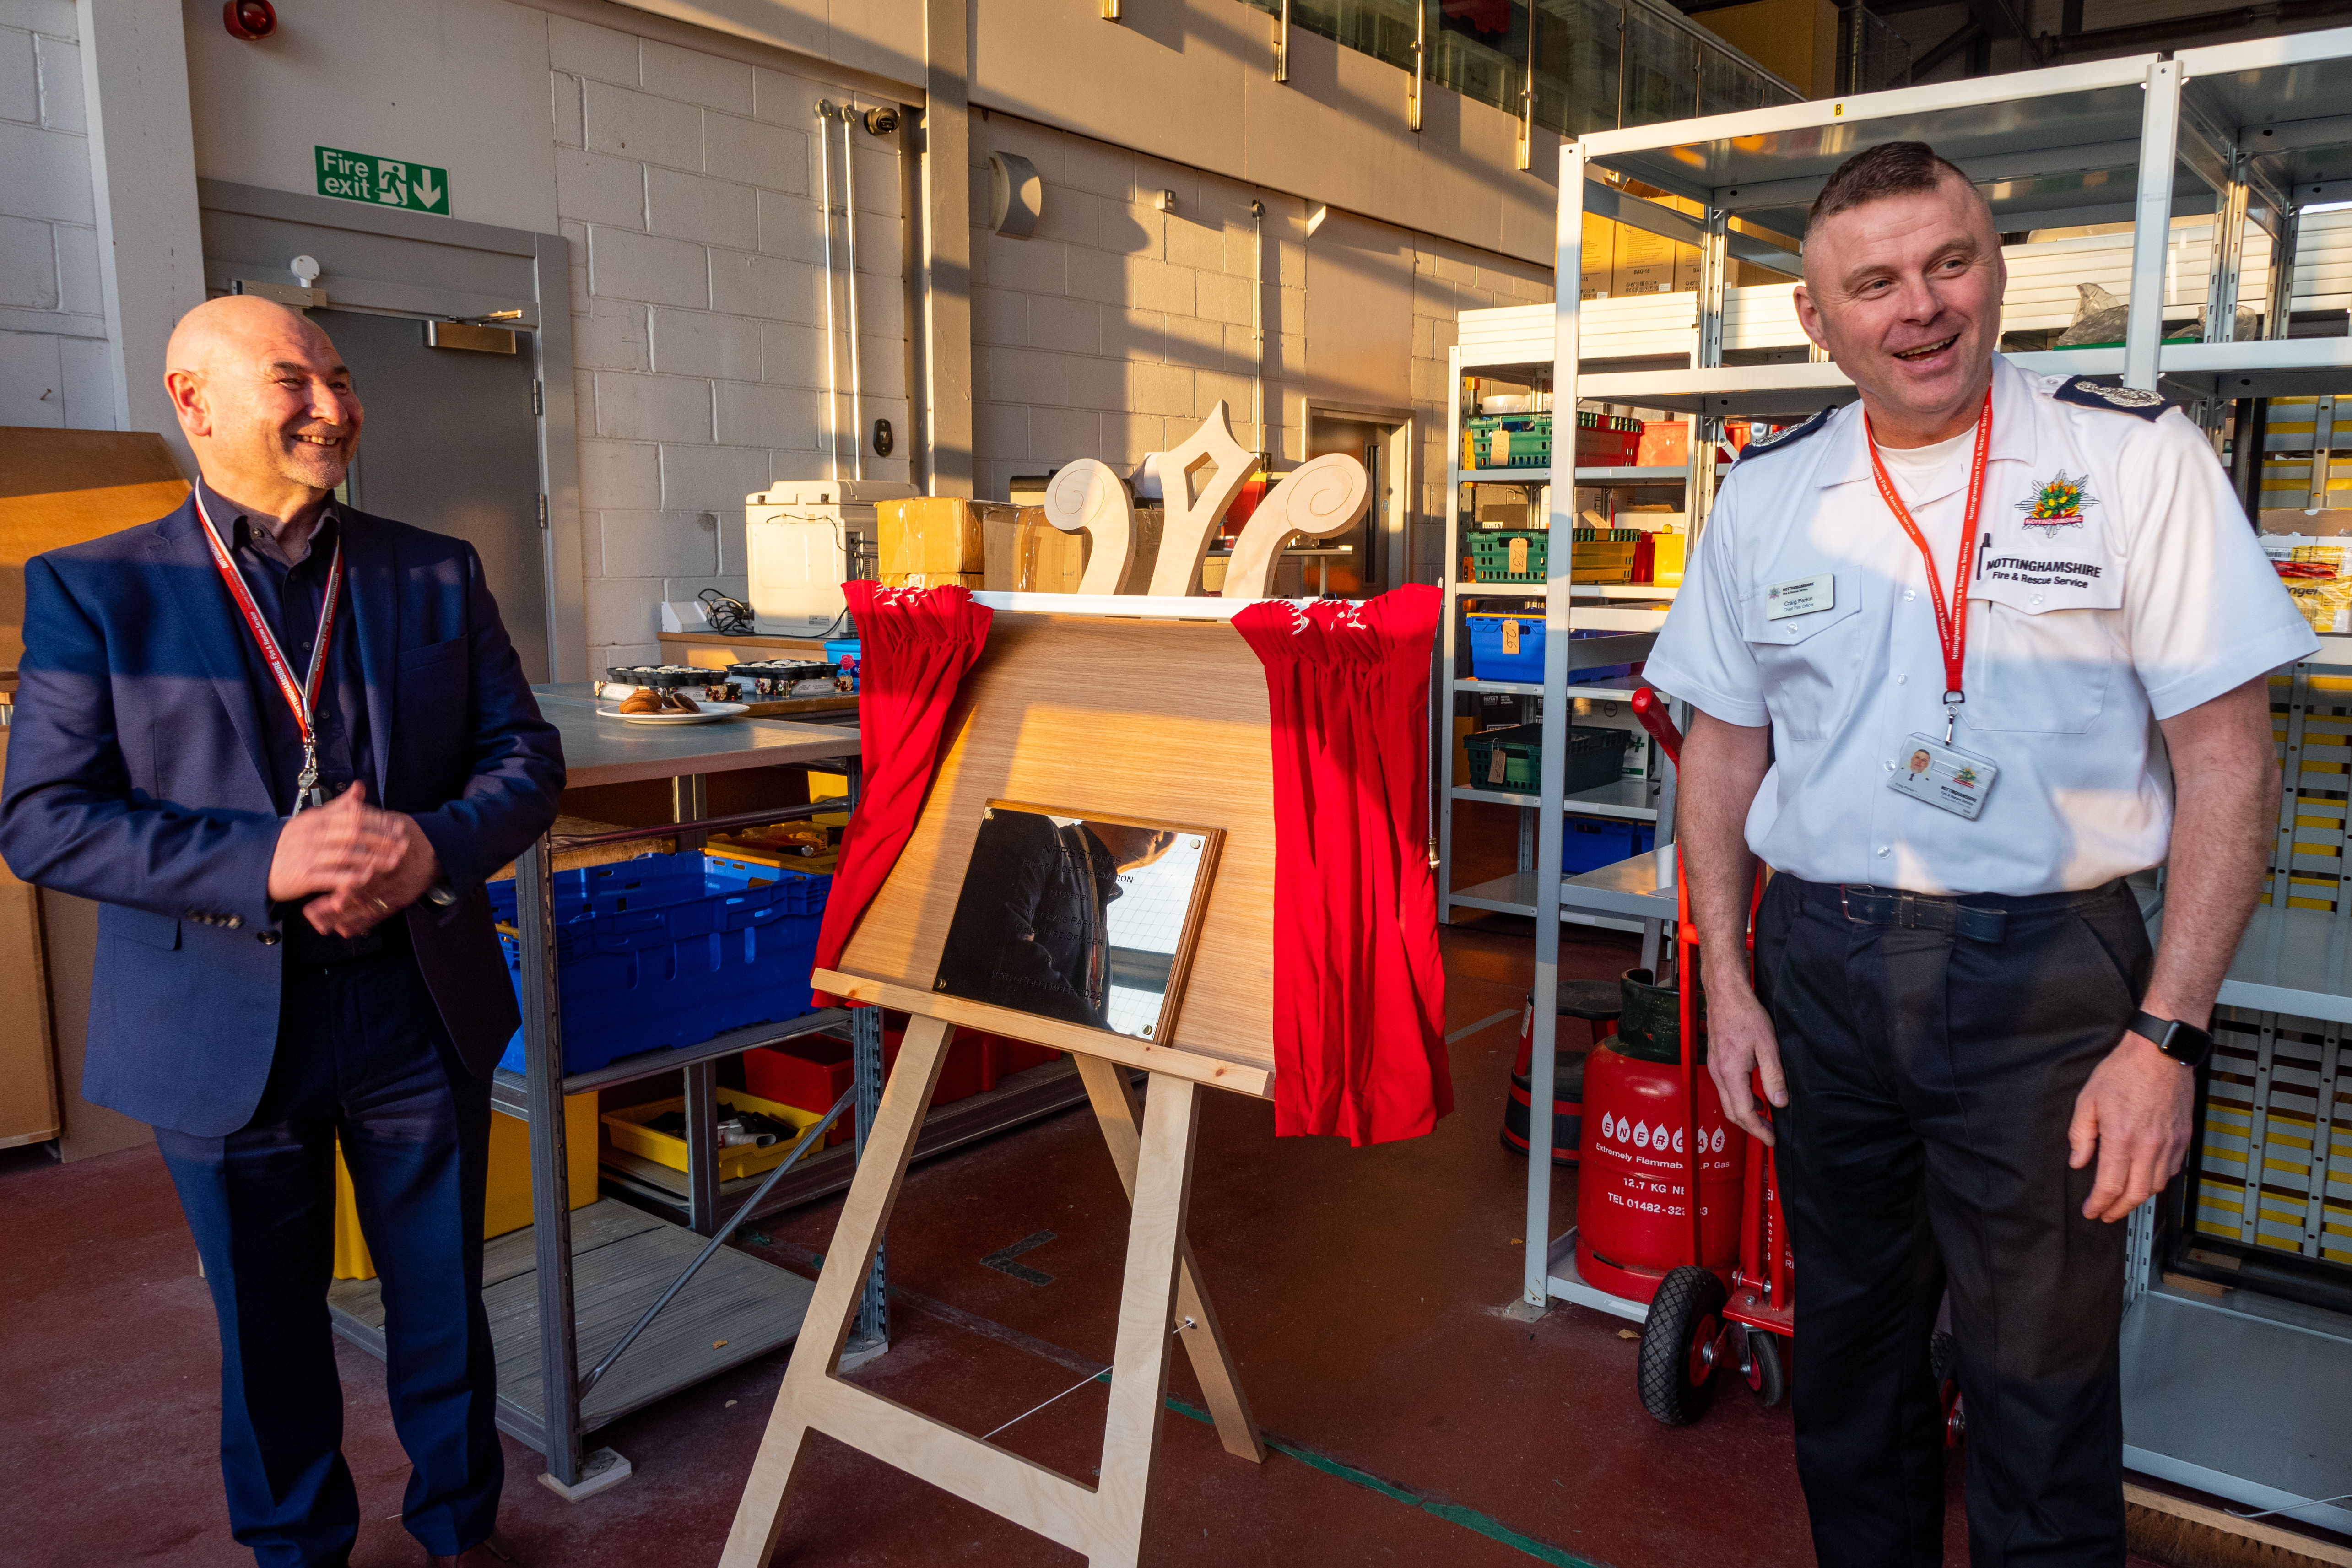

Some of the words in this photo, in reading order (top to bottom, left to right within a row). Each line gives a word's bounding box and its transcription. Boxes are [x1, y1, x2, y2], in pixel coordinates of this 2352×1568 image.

[1836, 104, 1841, 115] B
[322, 150, 369, 178] Fire
[324, 177, 371, 199] exit
[1968, 471, 1980, 520] Nottinghamshire
[1978, 428, 1986, 450] Rescue
[1888, 495, 1903, 515] Rescue
[1902, 515, 1915, 535] Service
[2026, 516, 2082, 525] NOTTINGHAMSHIRE
[1513, 549, 1524, 568] 23
[1961, 541, 1969, 564] Service
[1957, 565, 1966, 588] Rescue
[1986, 558, 2102, 578] NOTTINGHAMSHIRE
[1783, 582, 1814, 591] NOTTINGHAMSHIRE
[1992, 571, 2010, 580] Fire
[2021, 574, 2051, 584] Rescue
[2054, 576, 2088, 588] Service
[1925, 552, 1938, 600] Nottinghamshire
[1940, 618, 1949, 640] Rescue
[250, 612, 262, 628] Service
[259, 628, 270, 645] Rescue
[1506, 629, 1517, 648] 26
[1952, 608, 1961, 660] Nottinghamshire
[272, 661, 303, 718] NOTTINGHAMSHIRE
[1042, 844, 1076, 858] NFRS
[1078, 849, 1121, 865] STORES
[1022, 858, 1073, 874] HIGHFIELDS
[1075, 866, 1095, 877] FIRE
[1096, 871, 1134, 883] STATION
[1051, 889, 1079, 899] OPENED
[1026, 908, 1039, 918] MR
[1041, 911, 1068, 923] CRAIG
[1070, 917, 1103, 929] PARKIN
[1016, 923, 1043, 934] CHIEF
[1044, 928, 1064, 939] FIRE
[1066, 932, 1104, 946] OFFICER
[991, 970, 1012, 982] 16TH
[1027, 978, 1075, 995] DECEMBER
[1077, 989, 1102, 1000] 2022
[1596, 1142, 1632, 1162] Extremely
[1636, 1156, 1683, 1169] Flammab
[1623, 1178, 1645, 1190] 12.7
[1651, 1184, 1666, 1193] KG
[1672, 1186, 1684, 1195] NE
[1607, 1192, 1624, 1205] TEL
